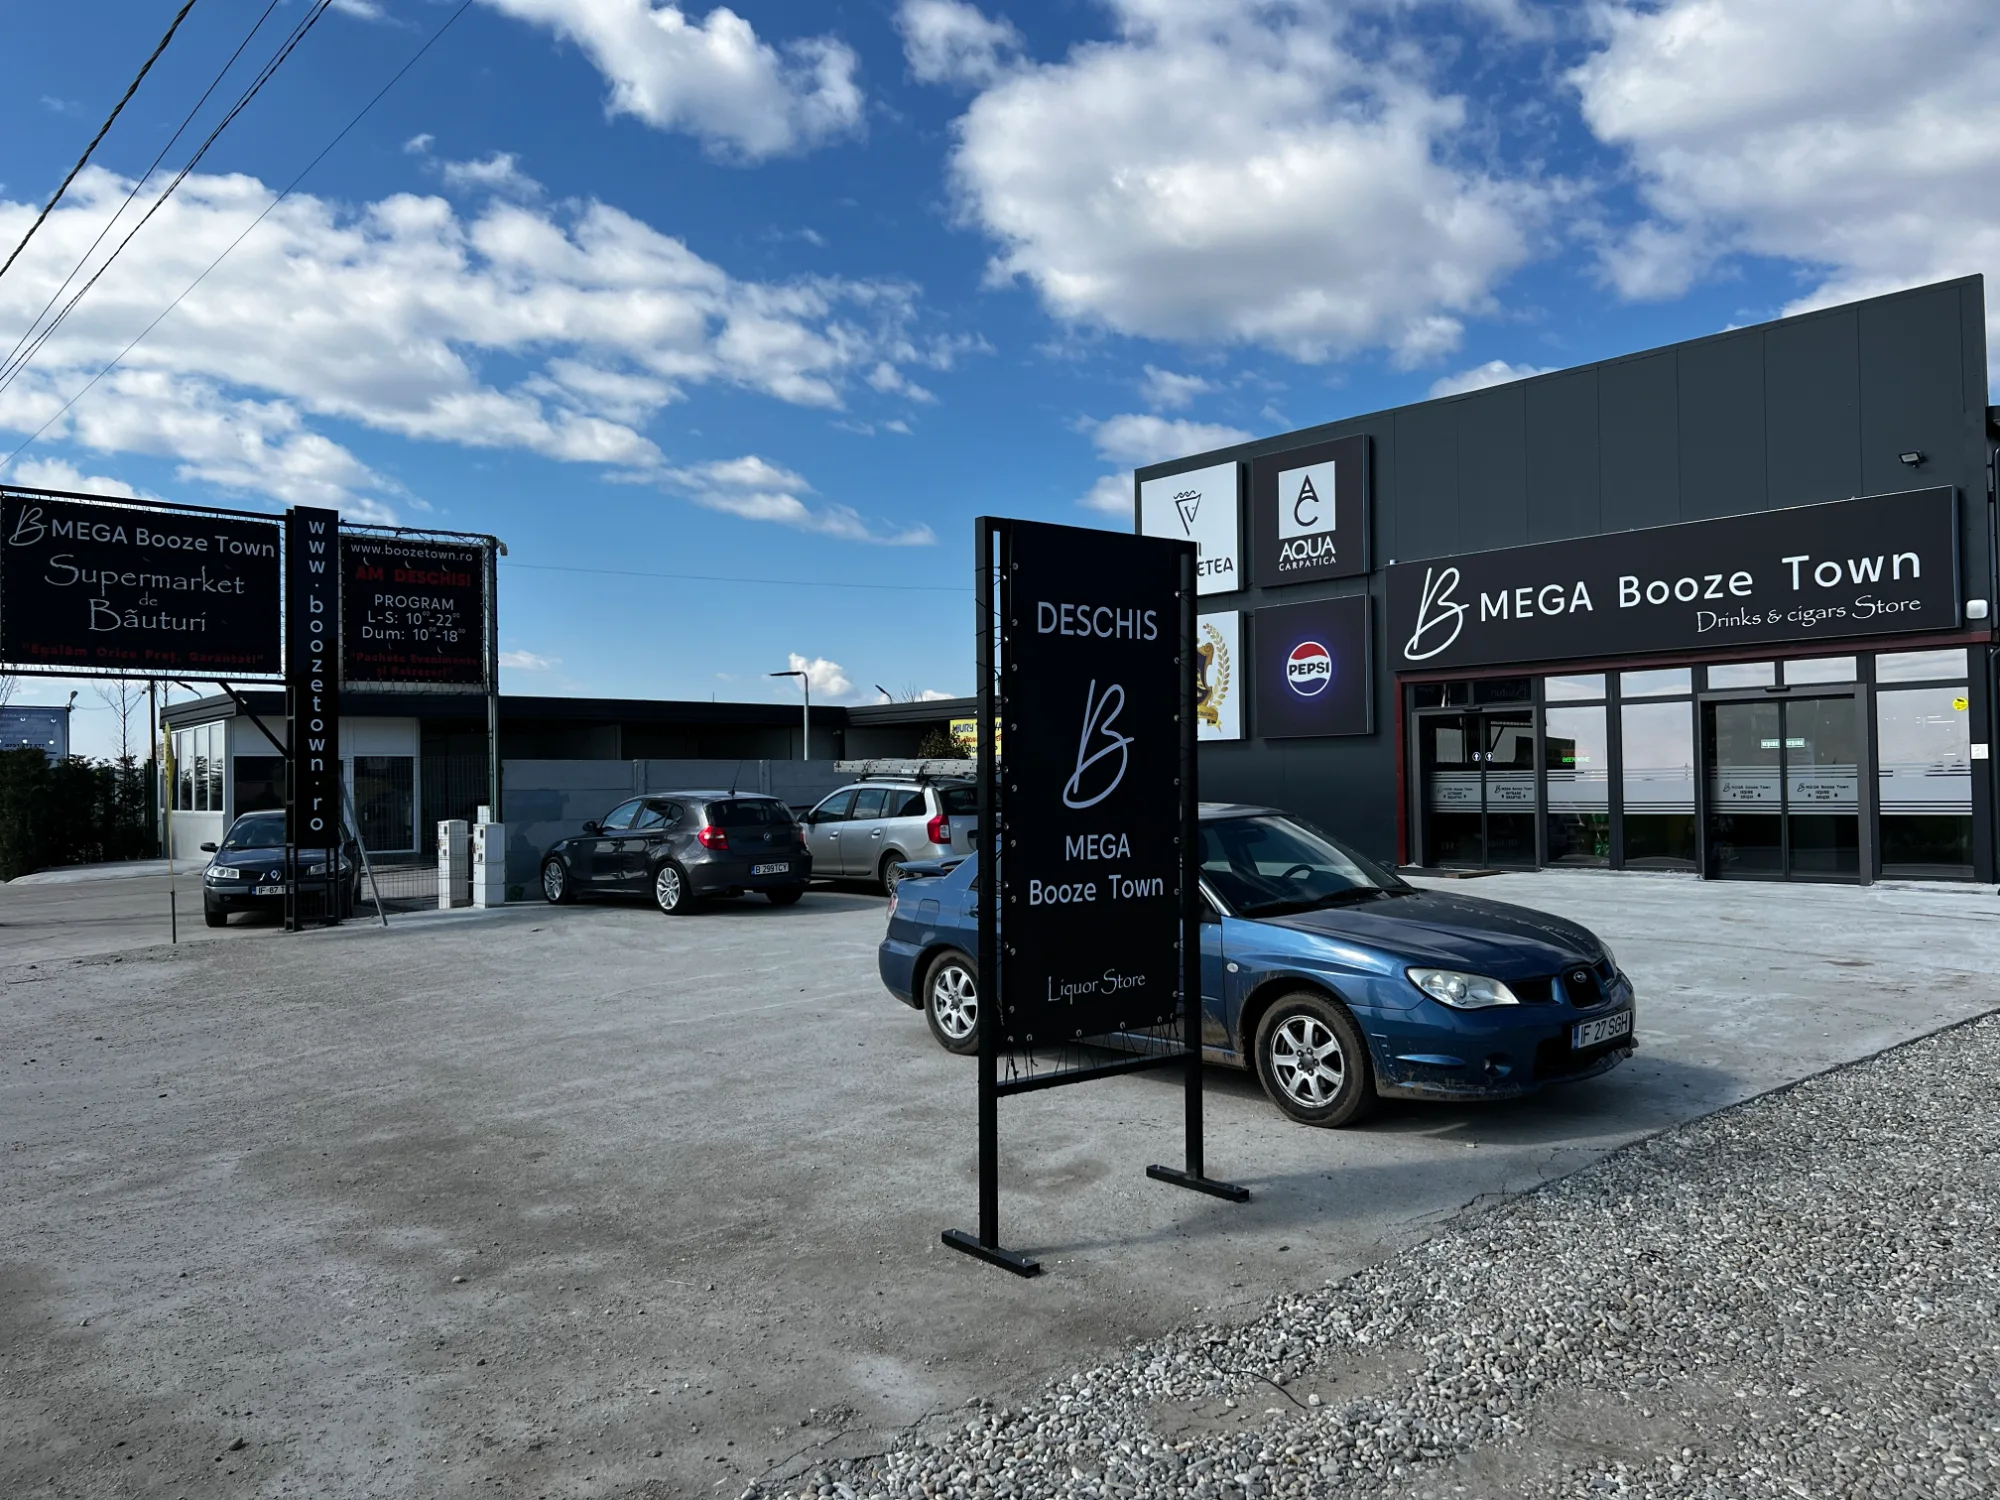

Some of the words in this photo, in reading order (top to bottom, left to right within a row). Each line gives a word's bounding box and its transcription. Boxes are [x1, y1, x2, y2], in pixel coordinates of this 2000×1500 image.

[52, 519, 128, 545] MEGA
[136, 528, 208, 552] Booze
[215, 535, 275, 558] Town
[1279, 535, 1336, 562] AQUA
[351, 543, 473, 562] www.boozetown.ro
[1279, 556, 1336, 571] CARPATICA
[44, 553, 245, 597] Supermarket
[355, 565, 384, 581] AM
[1197, 557, 1233, 577] ETEA
[138, 591, 158, 606] de
[374, 594, 454, 611] PROGRAM
[1404, 567, 1470, 661] B
[1480, 581, 1594, 622] MEGA
[1619, 570, 1754, 608] Booze
[1781, 551, 1921, 591] Town
[368, 610, 398, 624] L-S:
[1037, 601, 1158, 641] DESCHIS
[1696, 606, 1761, 633] Drinks
[1767, 609, 1782, 624] &
[1787, 605, 1846, 627] cigars
[1851, 595, 1922, 619] Store
[362, 626, 405, 640] Dum:
[96, 646, 138, 659] Orice
[1289, 661, 1330, 676] PEPSI
[1063, 678, 1135, 810] B
[1065, 833, 1131, 861] MEGA
[1029, 879, 1097, 905] Booze
[1108, 874, 1164, 899] Town
[1048, 975, 1099, 1005] Liquor
[1101, 968, 1146, 995] Store
[1580, 1024, 1592, 1045] IF
[1594, 1020, 1607, 1041] 27
[1608, 1012, 1628, 1036] SGH
